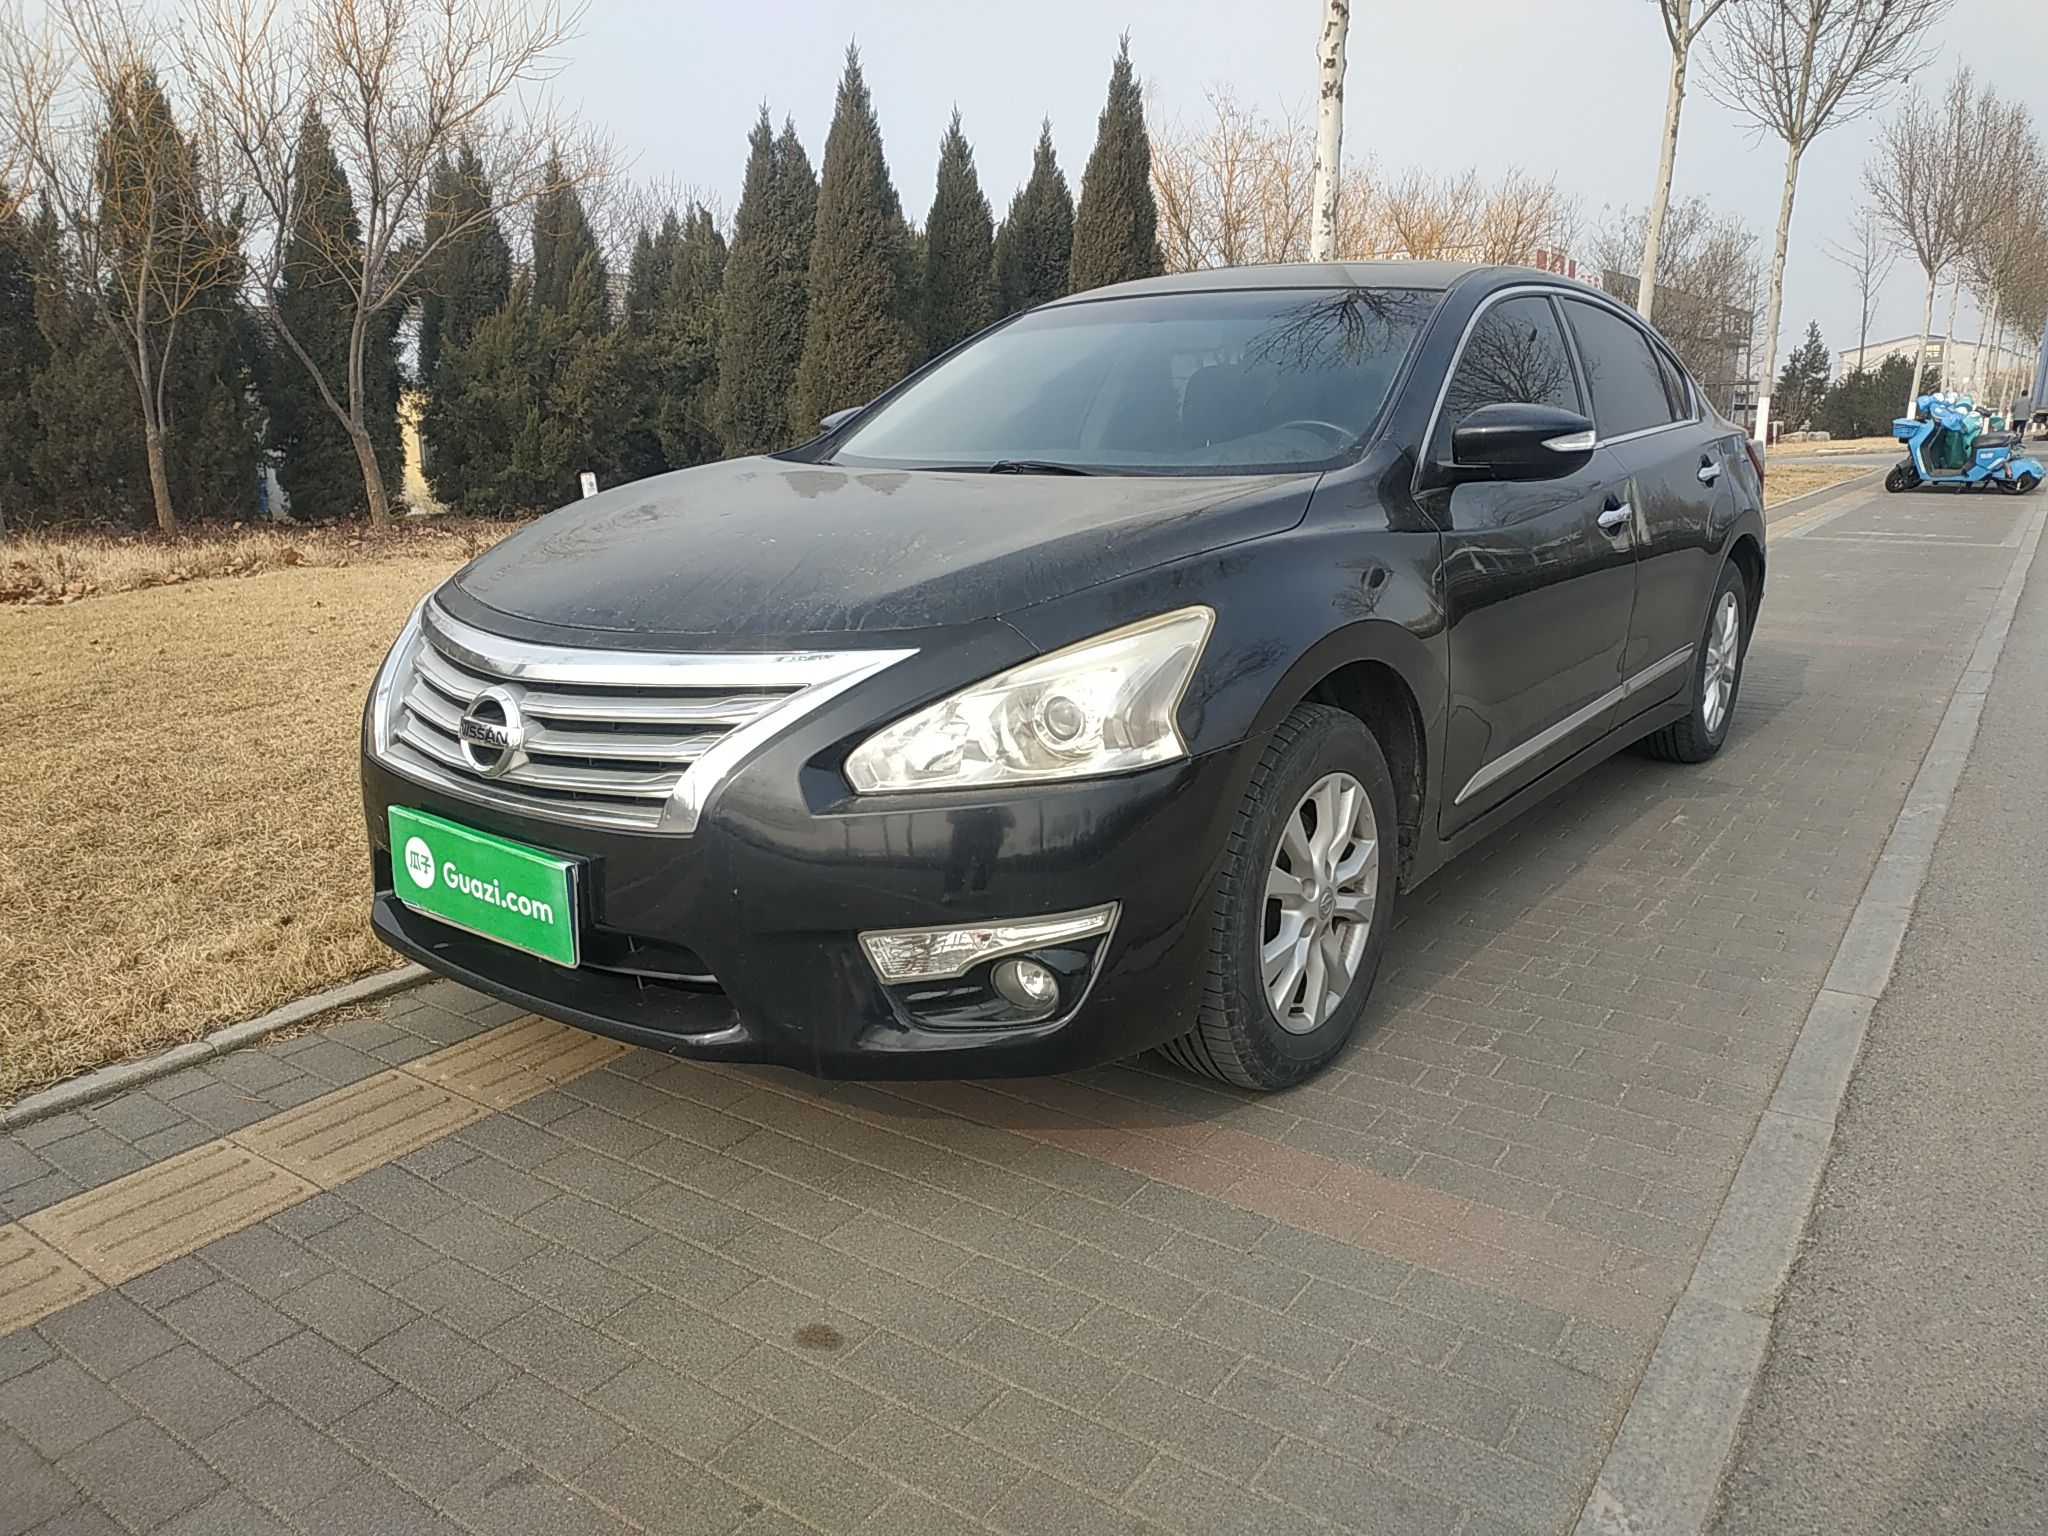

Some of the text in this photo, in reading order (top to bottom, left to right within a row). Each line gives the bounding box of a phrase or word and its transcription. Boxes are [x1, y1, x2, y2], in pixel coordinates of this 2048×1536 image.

[461, 722, 508, 745] NISSAN
[410, 850, 432, 874] 瓜子
[443, 861, 554, 925] Guazi.com
